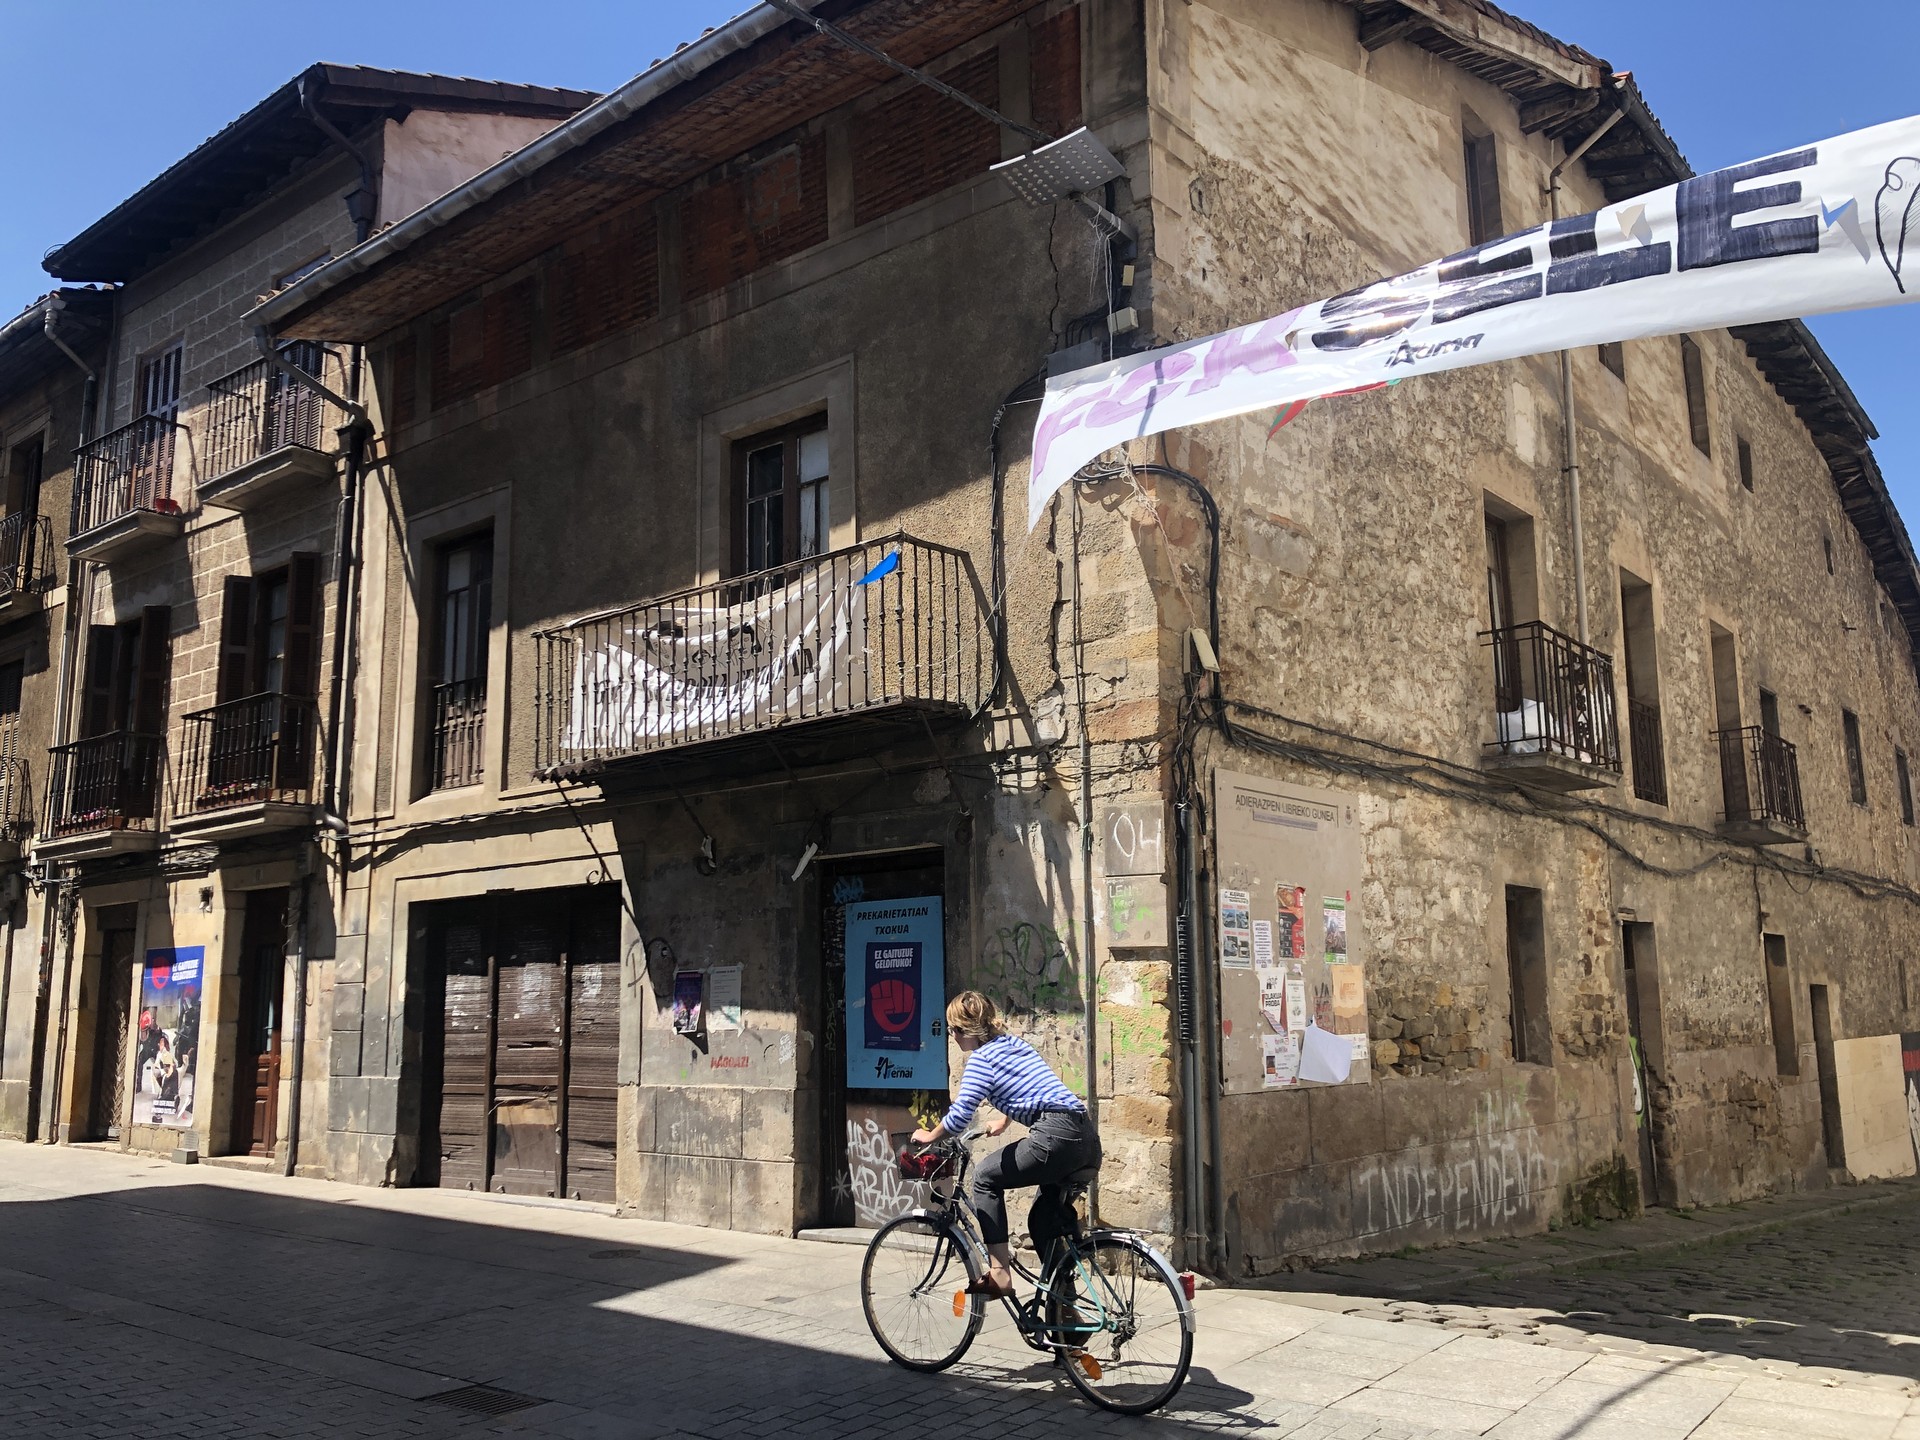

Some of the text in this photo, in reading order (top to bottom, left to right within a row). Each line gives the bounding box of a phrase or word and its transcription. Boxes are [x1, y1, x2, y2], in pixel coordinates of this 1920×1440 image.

[1235, 794, 1280, 812] ADIERAZPEN
[1281, 803, 1310, 818] LIBREKO
[857, 906, 929, 921] PREKARIETATIAN
[875, 924, 909, 935] TXOKUA
[874, 947, 914, 960] EZ GAITUZUE
